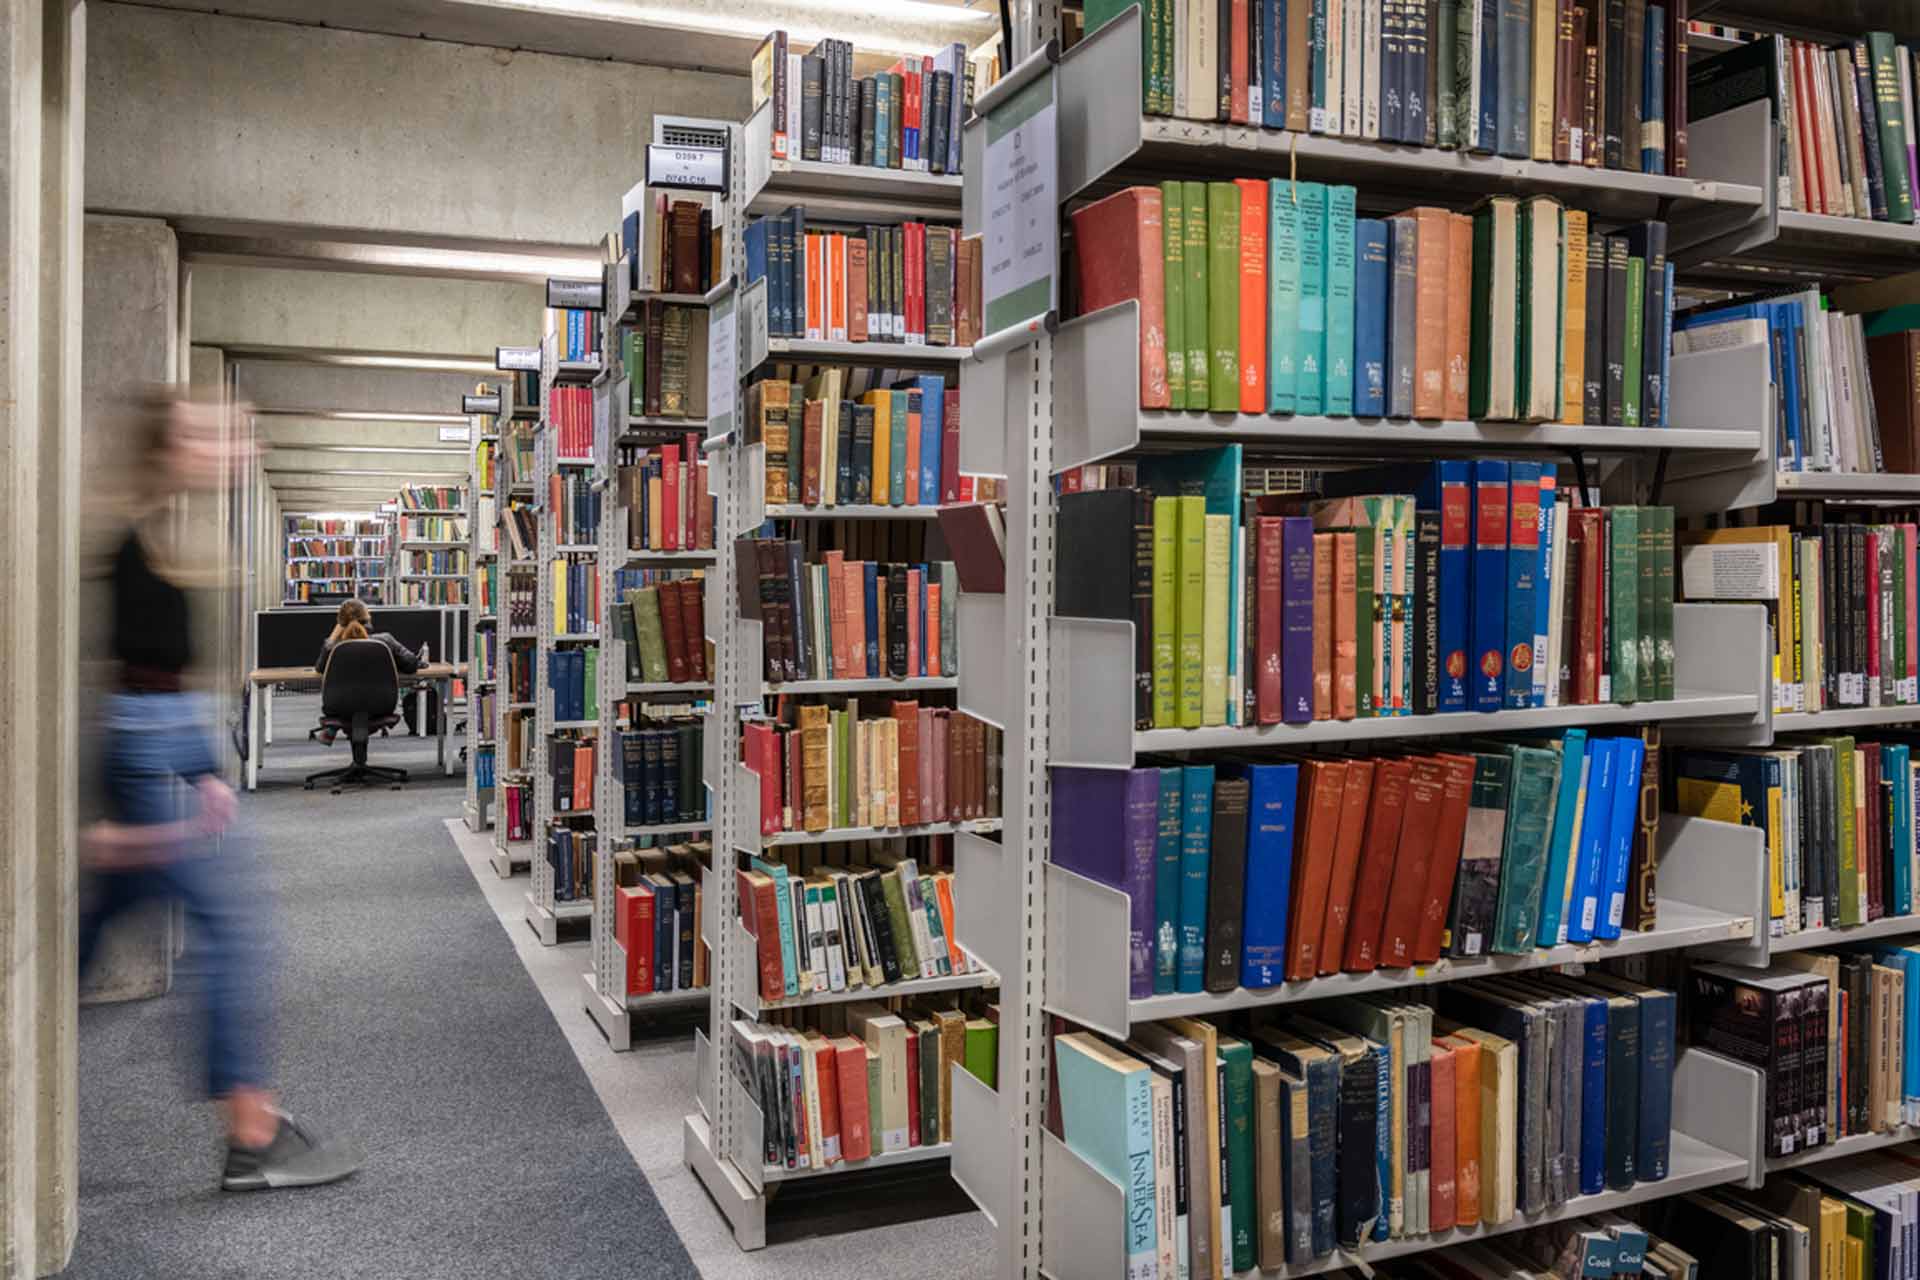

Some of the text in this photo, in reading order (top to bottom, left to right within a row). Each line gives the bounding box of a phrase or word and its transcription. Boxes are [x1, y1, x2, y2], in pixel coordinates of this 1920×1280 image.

[1538, 506, 1546, 532] 2000
[1427, 549, 1437, 573] THE
[1544, 548, 1552, 579] Europe
[1427, 576, 1437, 604] NEW
[1131, 1096, 1139, 1126] FOX
[1139, 1080, 1149, 1136] ROBERT
[1587, 1255, 1611, 1268] Cook
[1618, 1251, 1641, 1264] Cook
